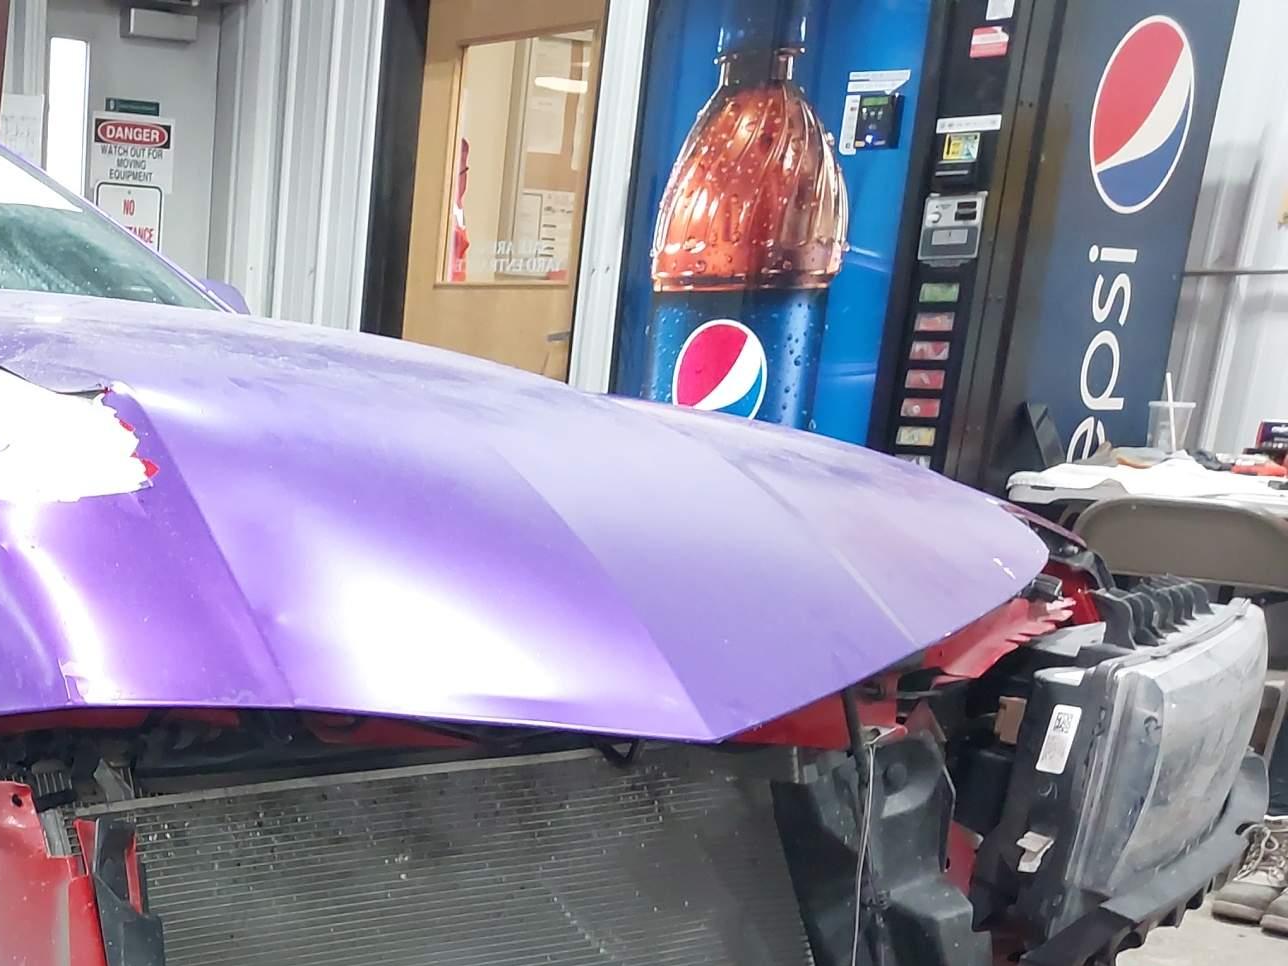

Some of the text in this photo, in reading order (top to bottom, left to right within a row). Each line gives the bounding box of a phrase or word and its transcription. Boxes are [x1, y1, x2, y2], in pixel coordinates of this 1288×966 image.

[106, 125, 160, 143] DANGER
[101, 144, 163, 160] WATCH OUT FOR
[116, 158, 146, 170] MOVING
[109, 168, 153, 183] EQUIPMENT
[123, 198, 136, 216] NO
[1066, 244, 1138, 464] epsi
